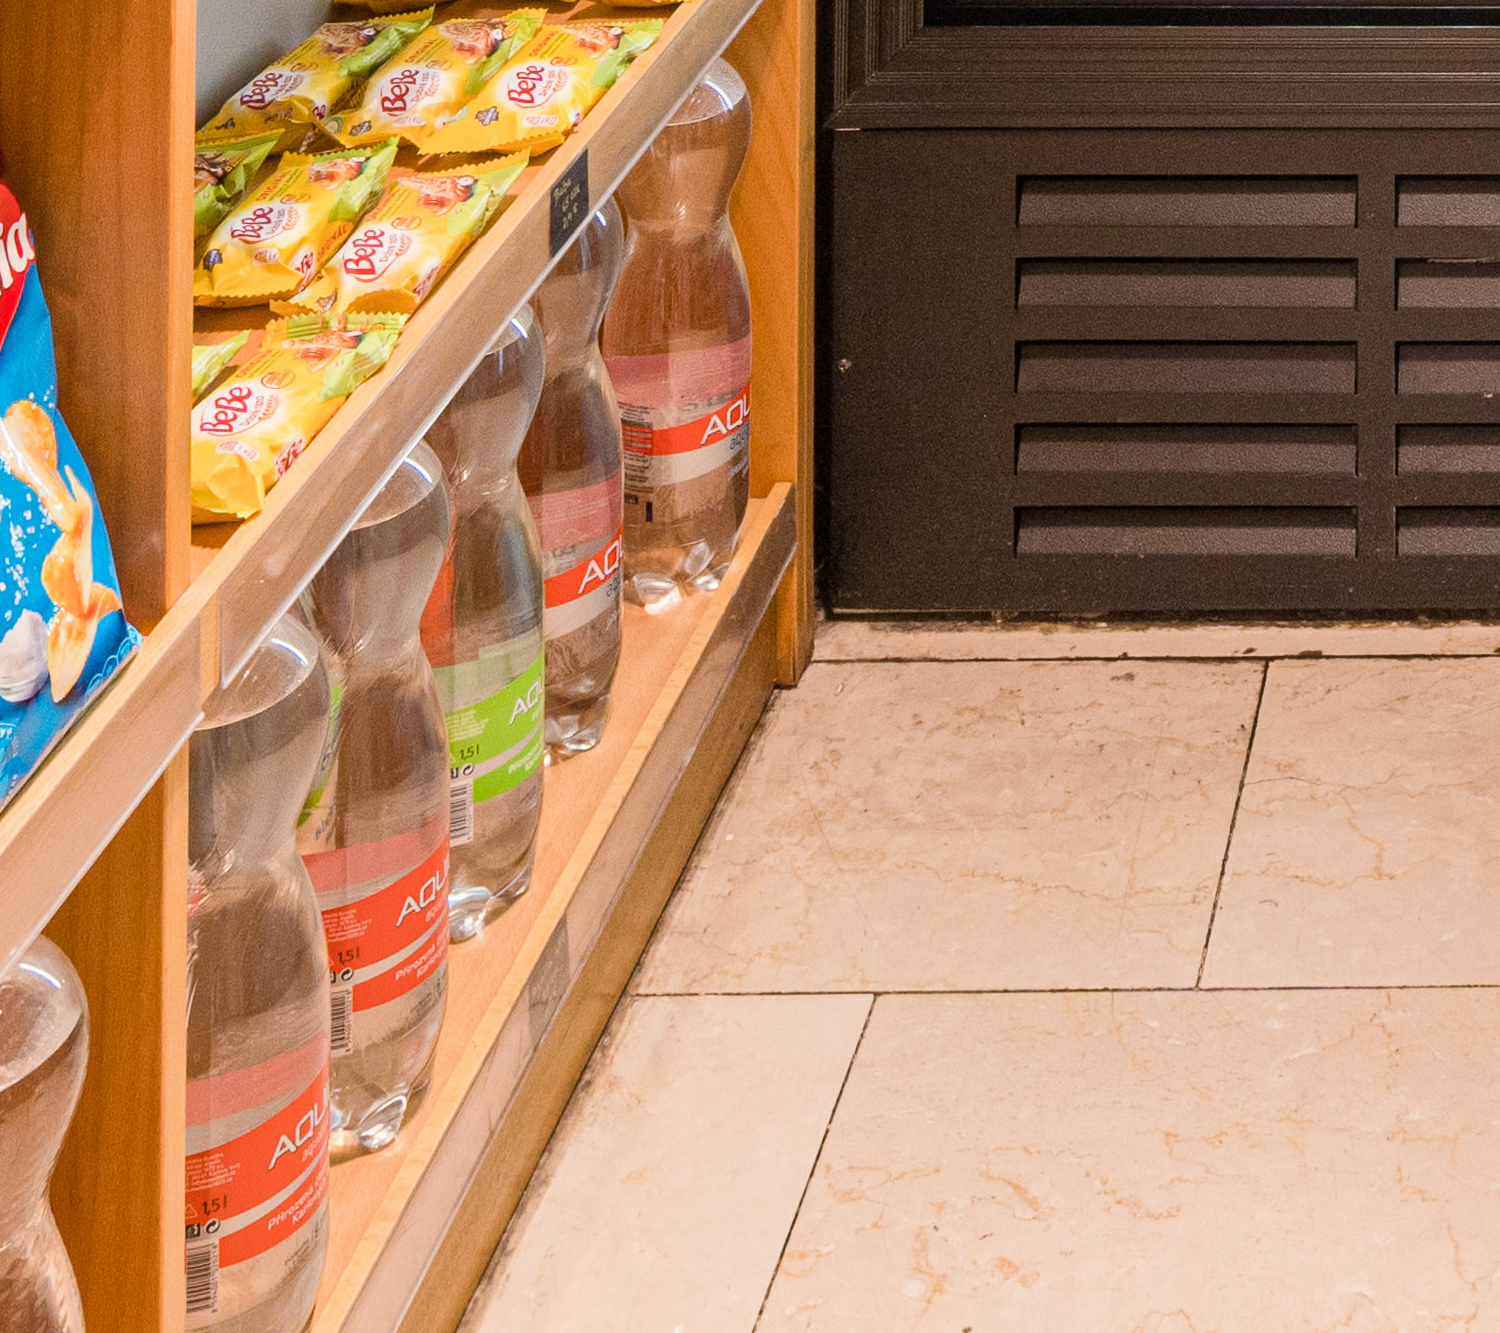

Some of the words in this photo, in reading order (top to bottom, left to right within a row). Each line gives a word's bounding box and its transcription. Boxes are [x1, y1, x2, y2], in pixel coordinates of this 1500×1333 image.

[381, 68, 420, 116] BeBe
[508, 65, 545, 108] BeBe
[345, 225, 387, 283] BeBe
[200, 387, 252, 438] BeBe
